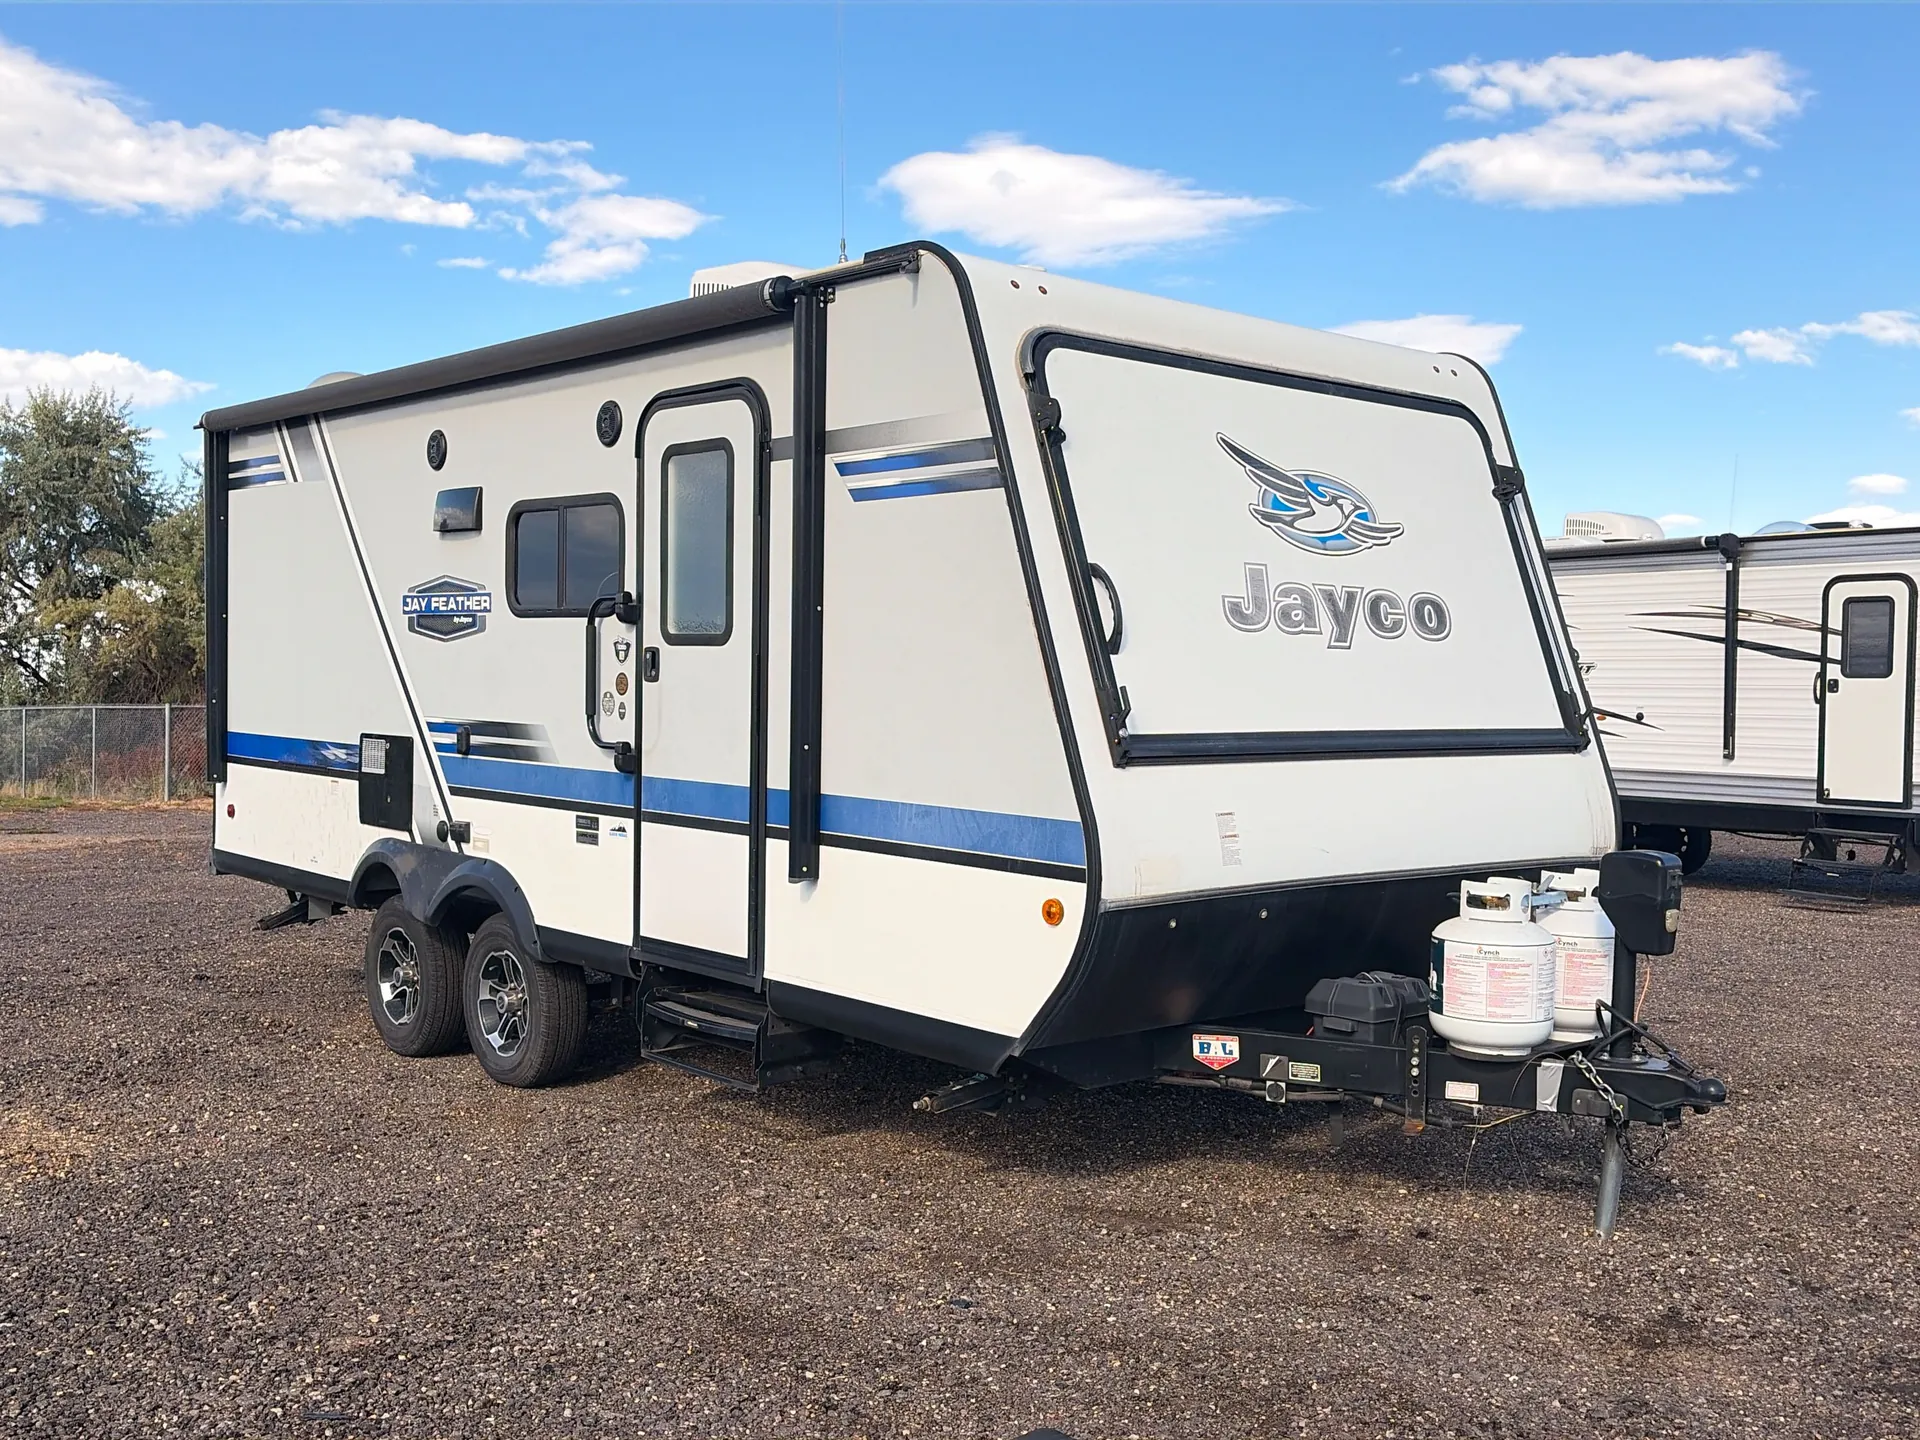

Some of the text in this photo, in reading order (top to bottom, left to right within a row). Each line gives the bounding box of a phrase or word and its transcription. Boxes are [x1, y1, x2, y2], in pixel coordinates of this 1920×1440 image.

[403, 595, 490, 611] JAY FEATHER
[1221, 562, 1452, 650] Jayco
[1558, 939, 1578, 947] Cynch
[1198, 1042, 1234, 1056] BL
